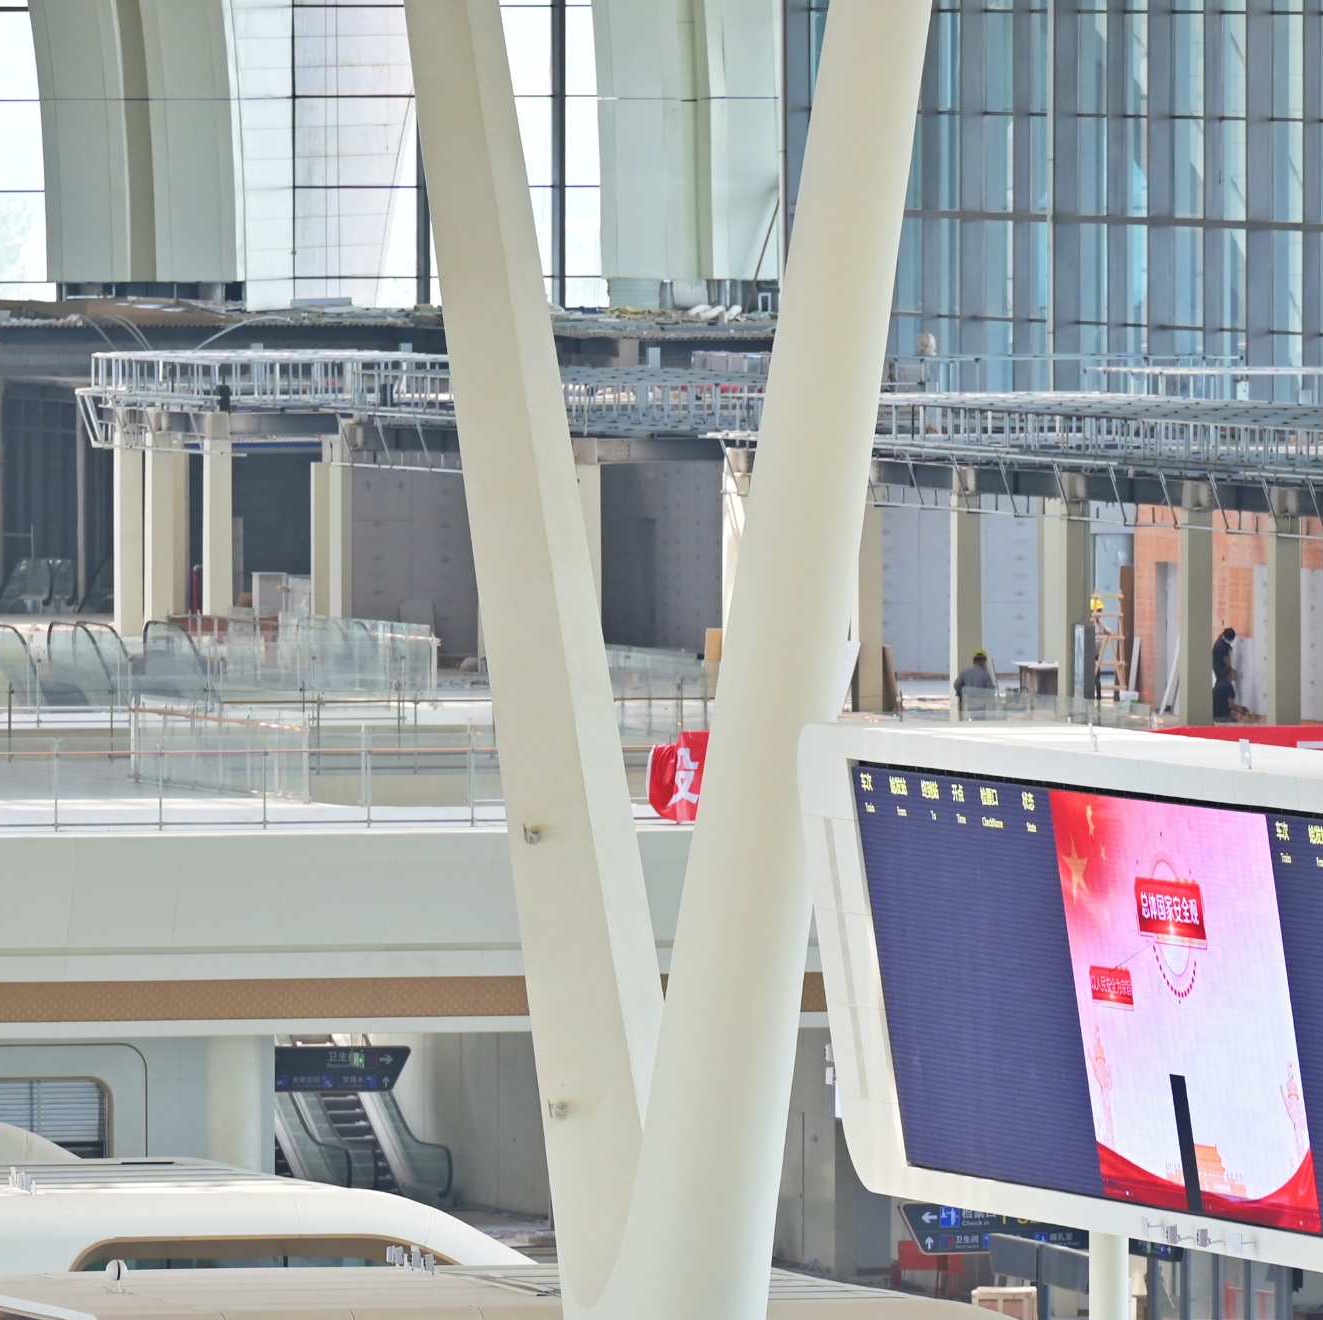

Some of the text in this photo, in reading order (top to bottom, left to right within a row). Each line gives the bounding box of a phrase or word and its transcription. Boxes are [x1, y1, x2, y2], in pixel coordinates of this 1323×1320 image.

[1275, 820, 1290, 841] 车次
[1140, 891, 1200, 926] 总体国家安全观
[327, 1051, 351, 1063] 卫生
[955, 1235, 979, 1244] 卫生间
